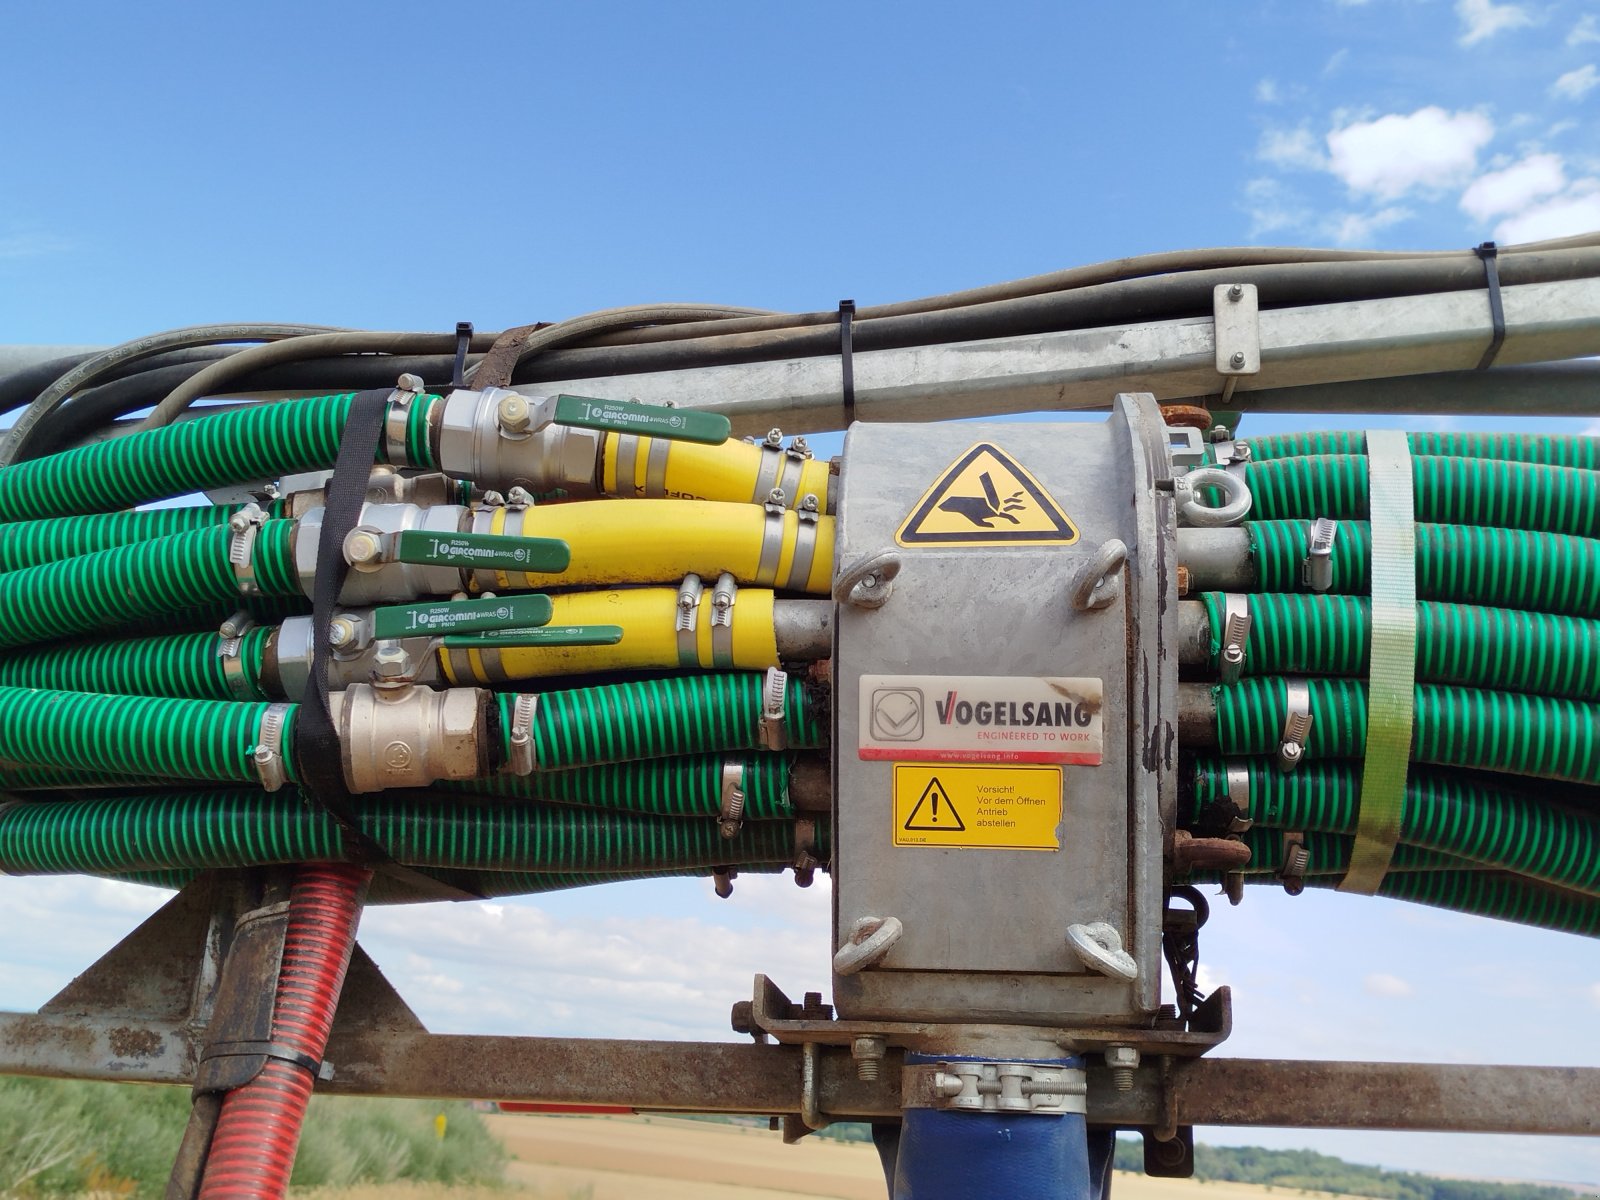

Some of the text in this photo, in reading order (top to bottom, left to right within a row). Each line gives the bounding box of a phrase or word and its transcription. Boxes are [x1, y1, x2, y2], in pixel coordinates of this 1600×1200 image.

[602, 411, 649, 423] GIACOMINI
[450, 546, 494, 558] GIACOMINI
[429, 612, 476, 623] GIACOMINI
[936, 690, 1092, 728] VOGELSANG
[977, 731, 1090, 742] ENGINEERED TO WORK
[940, 752, 1019, 761] www.vogelsang.info
[976, 785, 1015, 794] Vorsicht!
[976, 795, 1046, 806] Vor dem Öffnen
[976, 808, 1008, 816] Antrieb
[976, 818, 1016, 828] abstellen
